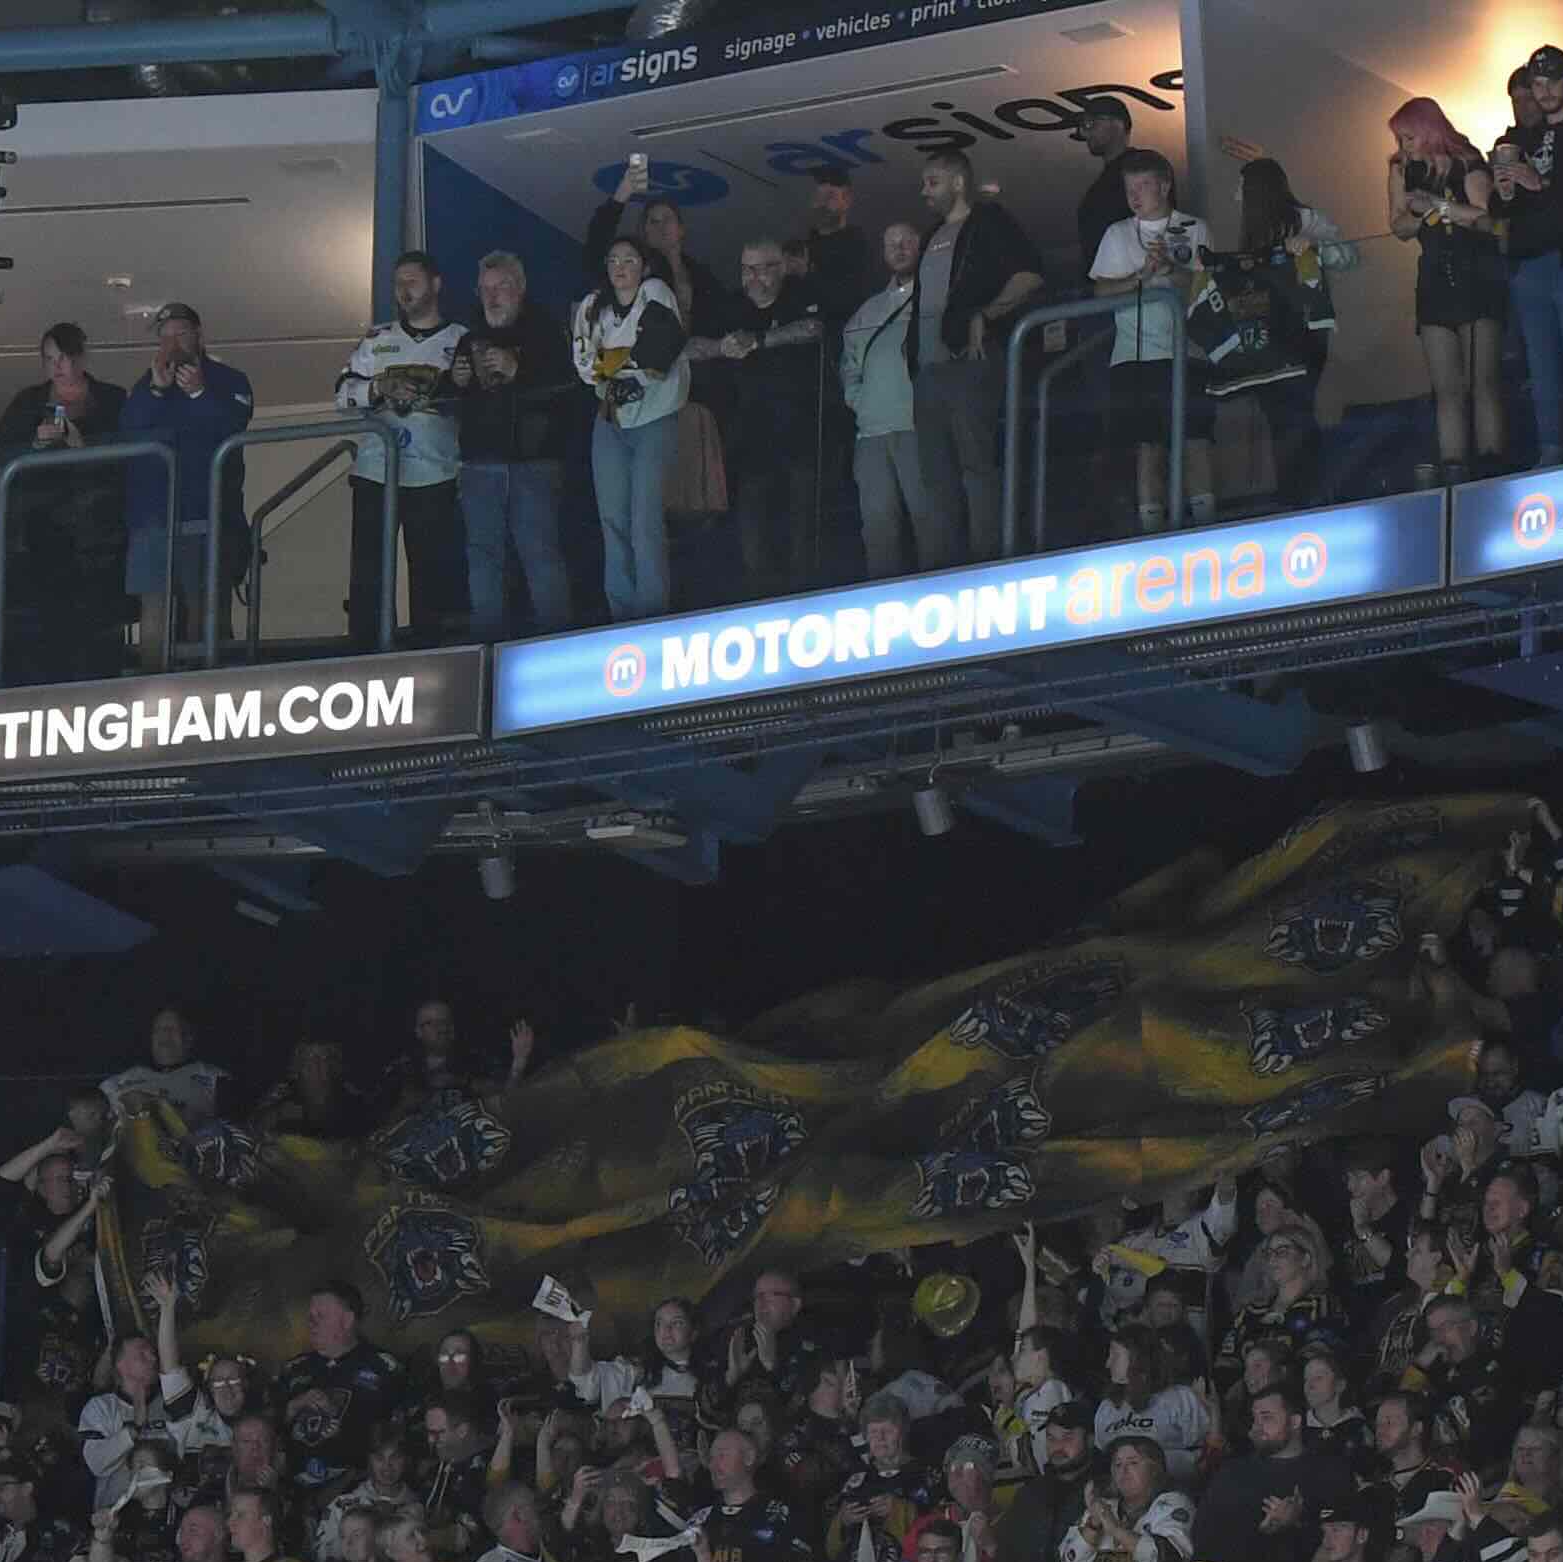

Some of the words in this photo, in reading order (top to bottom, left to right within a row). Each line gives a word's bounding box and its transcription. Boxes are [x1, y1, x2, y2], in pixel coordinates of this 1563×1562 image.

[724, 30, 796, 62] signage
[816, 12, 891, 41] vehicles
[911, 0, 956, 27] print
[591, 43, 698, 87] arsigns
[661, 577, 1056, 691] MOTORPOINT
[1066, 542, 1264, 625] arena
